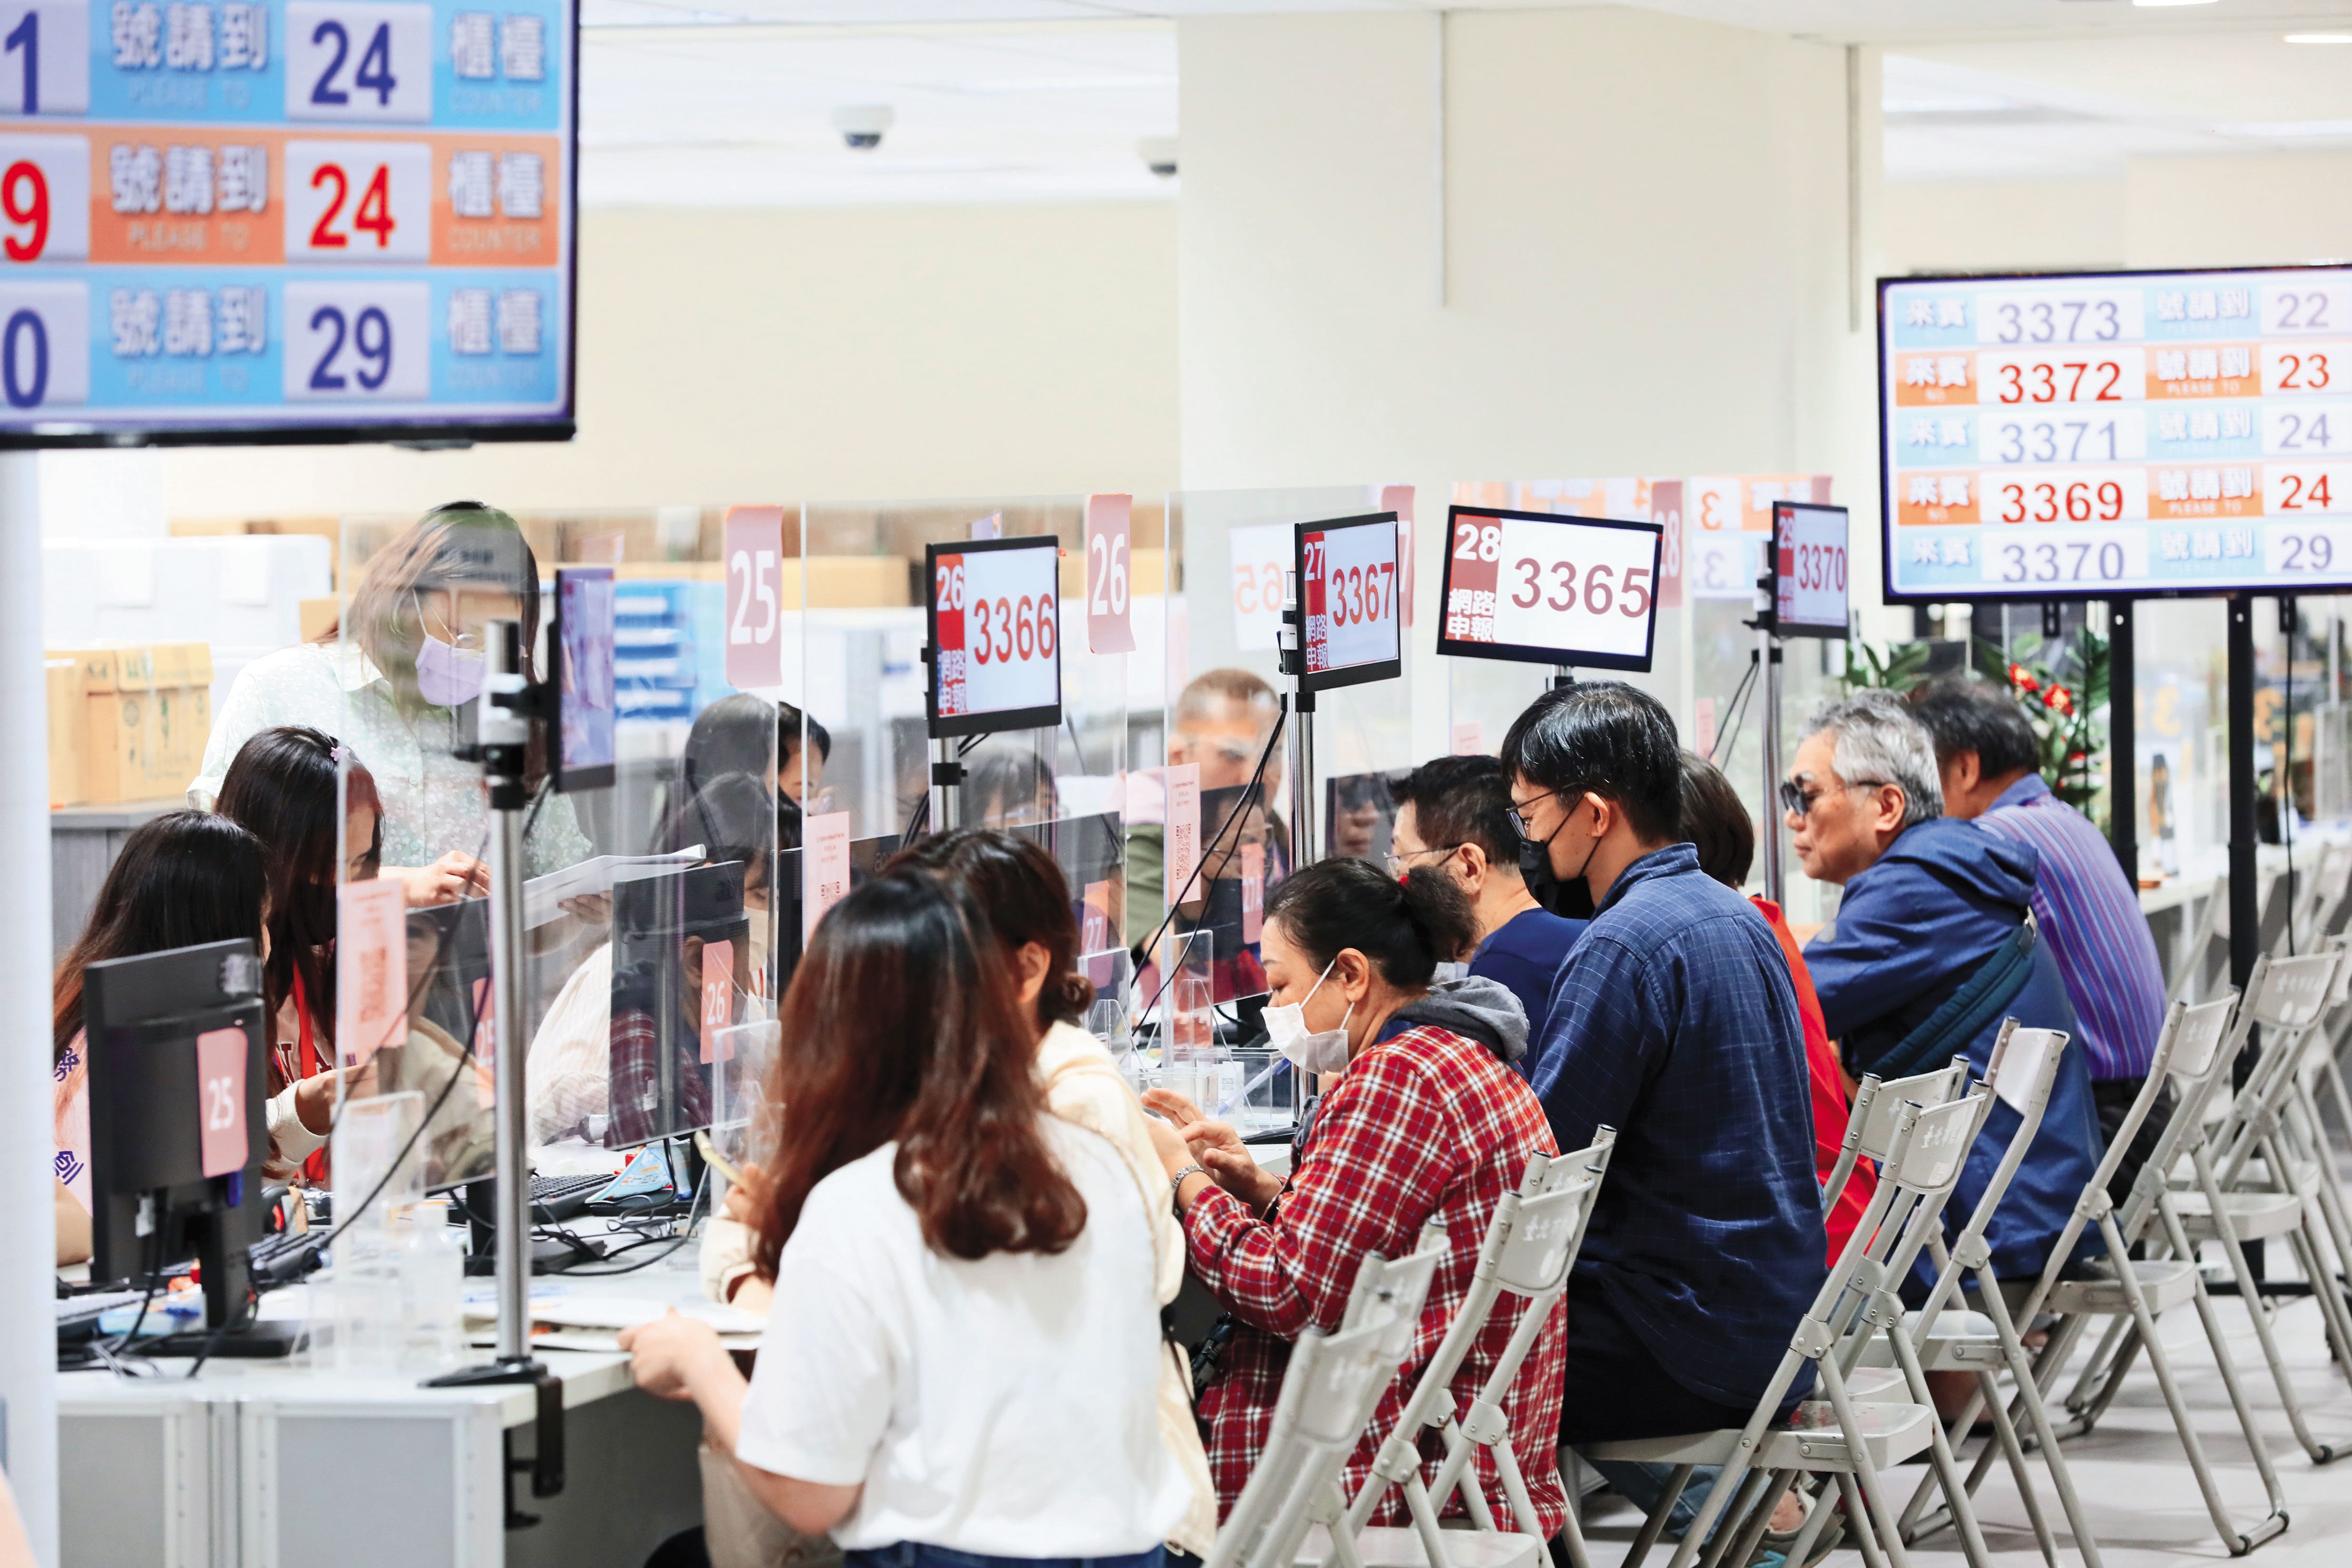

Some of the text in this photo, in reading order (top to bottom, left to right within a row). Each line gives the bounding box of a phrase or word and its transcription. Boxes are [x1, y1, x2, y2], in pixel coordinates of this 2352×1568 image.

[4, 9, 39, 115] 1
[111, 3, 268, 72] 號請到
[310, 20, 396, 106] 24
[2, 159, 50, 262] 9
[111, 145, 268, 213] 號請到
[309, 162, 395, 248] 24
[1997, 300, 2121, 344] 3373
[2277, 292, 2329, 328] 22
[4, 308, 48, 409] 0
[111, 287, 268, 356] 號請到
[309, 306, 392, 389] 29
[2000, 361, 2122, 404] 3372
[2279, 354, 2330, 389] 23
[2001, 420, 2118, 463] 3371
[2280, 413, 2332, 449] 24
[2001, 482, 2123, 524] 3369
[2281, 475, 2333, 509] 24
[1304, 541, 1325, 581] 27
[1454, 523, 1501, 563] 28
[2003, 542, 2124, 583] 3370
[2282, 535, 2333, 571] 29
[937, 565, 964, 611] 26
[1091, 533, 1126, 616] 26
[1512, 557, 1651, 618] 3365
[1800, 544, 1846, 592] 3370
[730, 550, 776, 645] 25
[1332, 562, 1395, 628] 3367
[1447, 587, 1495, 622] 網路
[973, 593, 1055, 665] 3366
[1306, 613, 1327, 643] 網路
[1447, 613, 1494, 642] 申報
[1306, 643, 1328, 671] 申報
[1085, 916, 1102, 955] 27
[707, 981, 725, 1025] 26
[209, 1076, 235, 1131] 25
